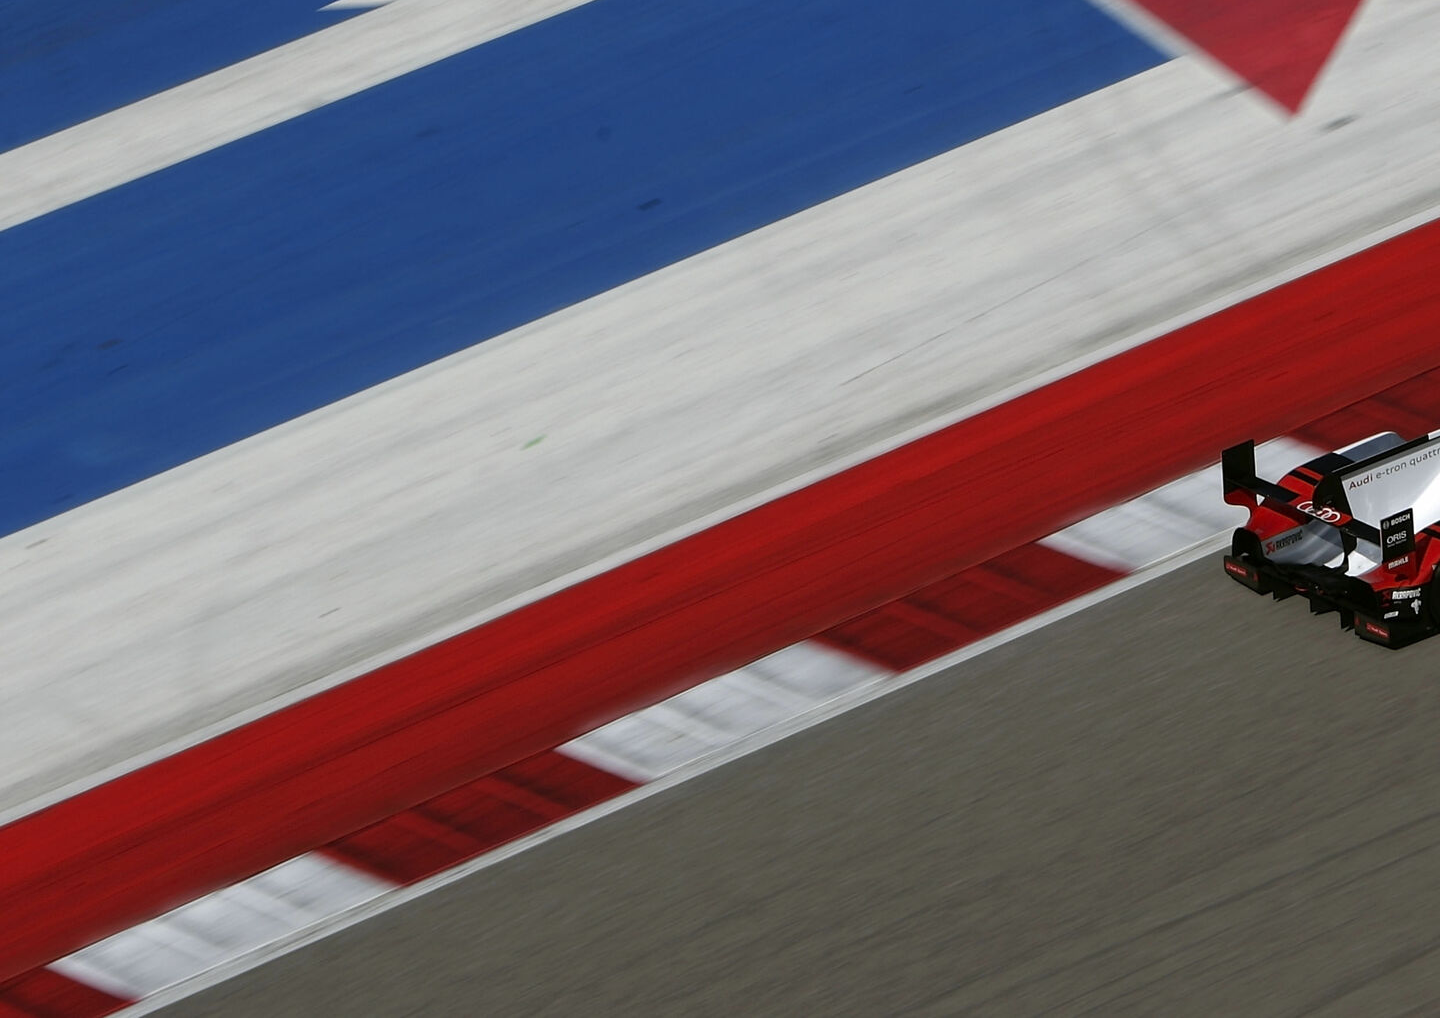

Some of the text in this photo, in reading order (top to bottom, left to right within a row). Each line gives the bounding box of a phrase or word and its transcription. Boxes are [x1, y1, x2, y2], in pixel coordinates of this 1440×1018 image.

[1349, 475, 1373, 490] Audi
[1375, 461, 1407, 479] e-tron
[1391, 513, 1411, 526] BOSCH
[1386, 530, 1407, 544] ORIS
